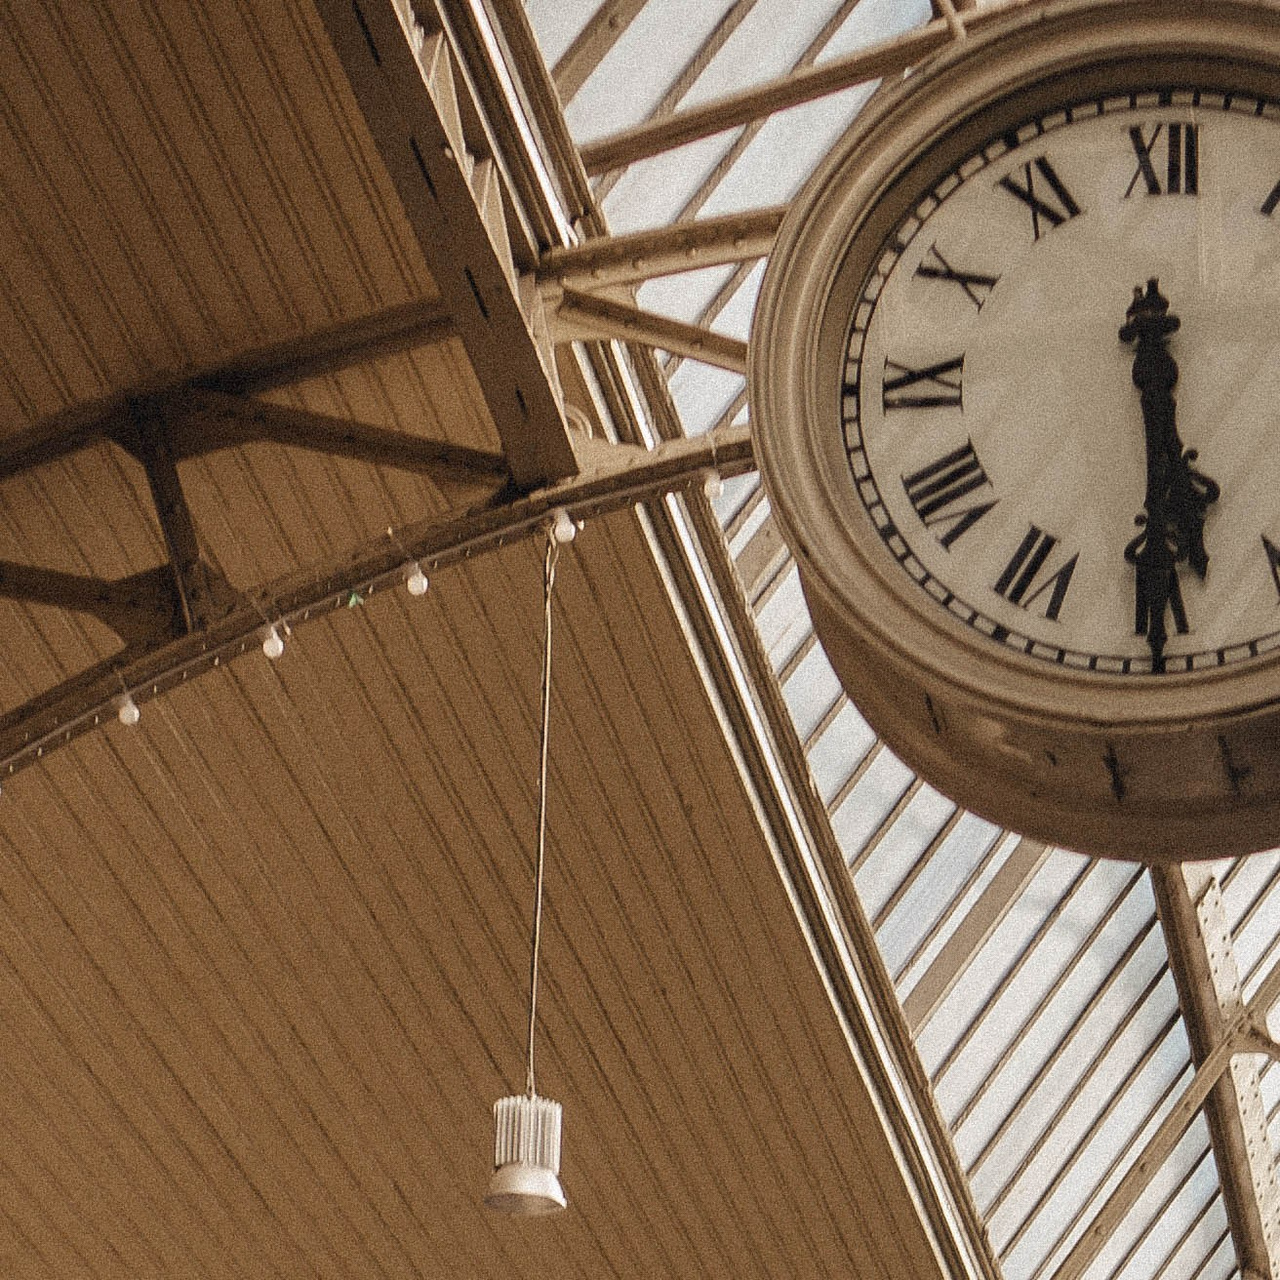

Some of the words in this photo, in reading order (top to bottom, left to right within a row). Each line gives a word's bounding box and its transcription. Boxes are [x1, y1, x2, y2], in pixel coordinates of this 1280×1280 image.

[998, 155, 1084, 241] XI
[1124, 123, 1200, 197] XII
[914, 243, 998, 311] X
[882, 353, 967, 416] IX
[901, 438, 1002, 551] VIII
[993, 523, 1081, 623] VII
